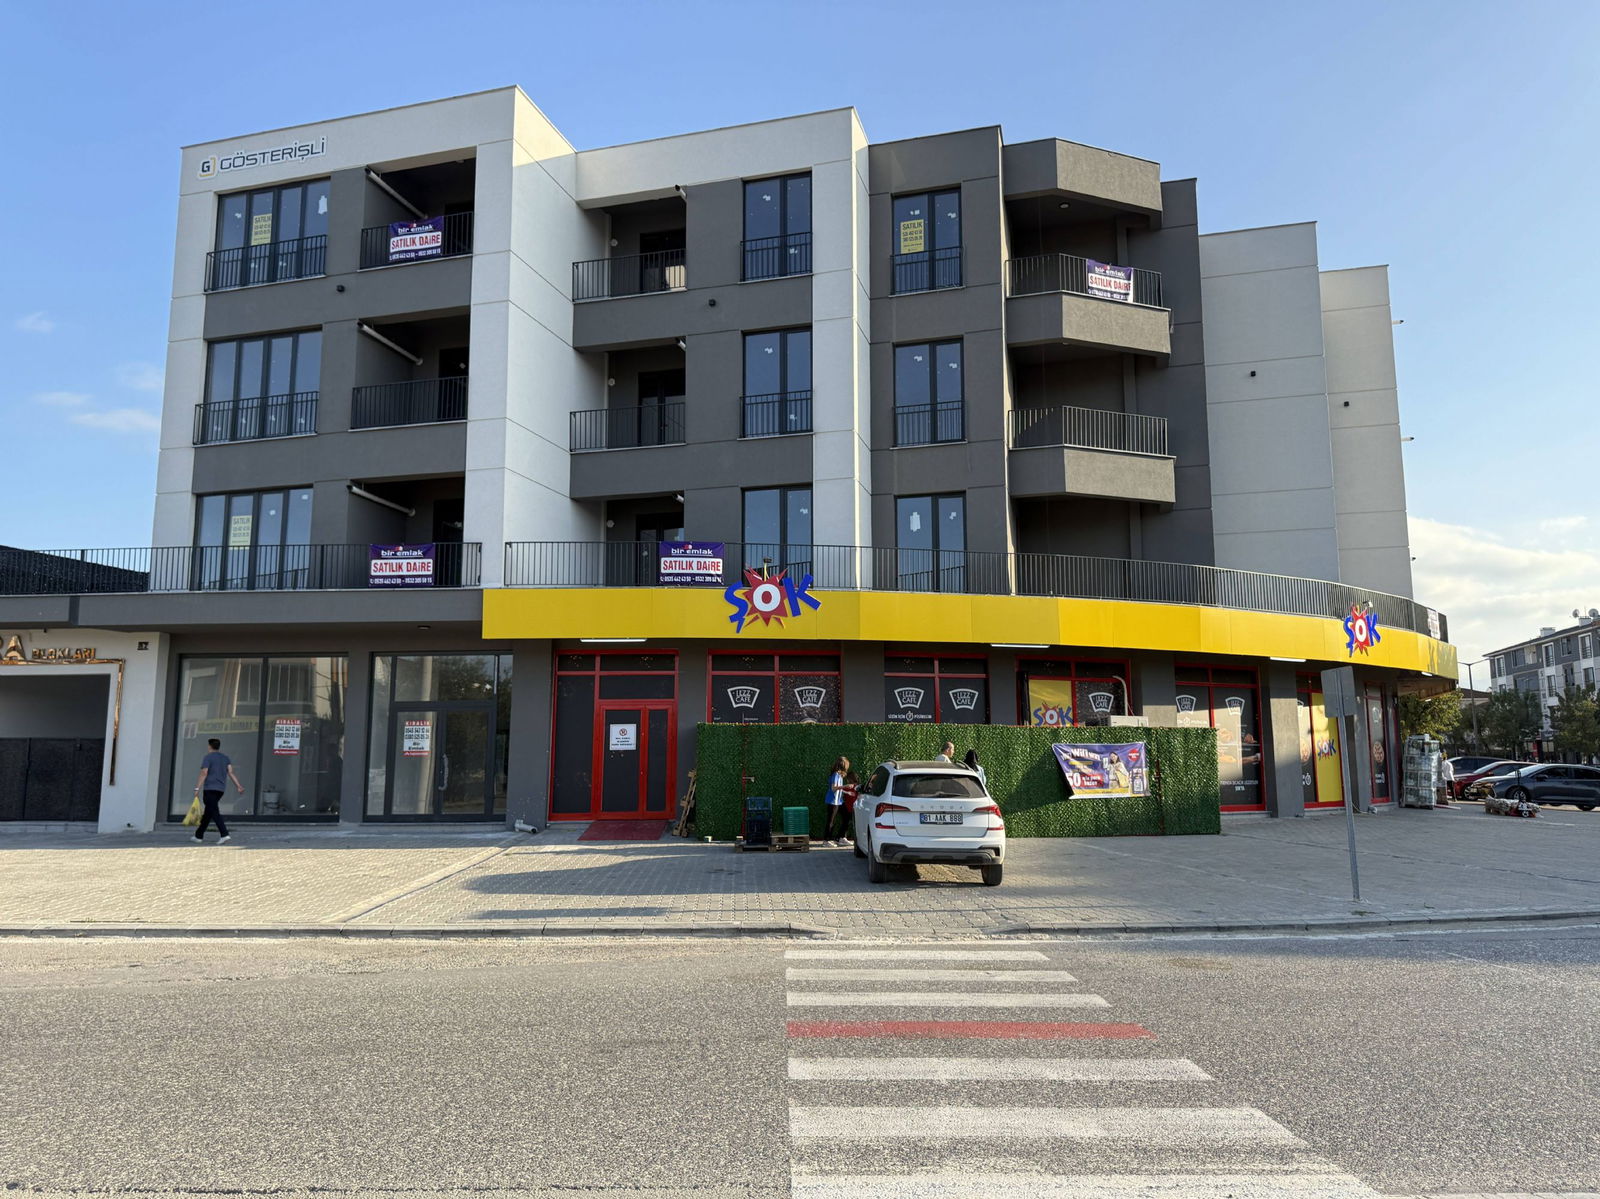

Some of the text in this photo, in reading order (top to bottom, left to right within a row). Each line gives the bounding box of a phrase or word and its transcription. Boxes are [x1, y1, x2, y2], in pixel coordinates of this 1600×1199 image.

[201, 137, 325, 173] G GÖSTERİŞLİ
[902, 221, 923, 231] SATILIK
[391, 234, 441, 250] SATILIK DAİRE
[1089, 275, 1112, 289] SATILIK
[373, 561, 431, 573] SATILIK DAİRE
[663, 559, 721, 572] SATILIK DAİRE
[724, 574, 821, 633] ŞOK
[1343, 613, 1381, 658] ŞOK
[32, 648, 97, 659] BLOKLARI
[735, 689, 751, 697] LEZZ
[802, 689, 817, 697] LEZZ
[934, 814, 947, 822] AAK
